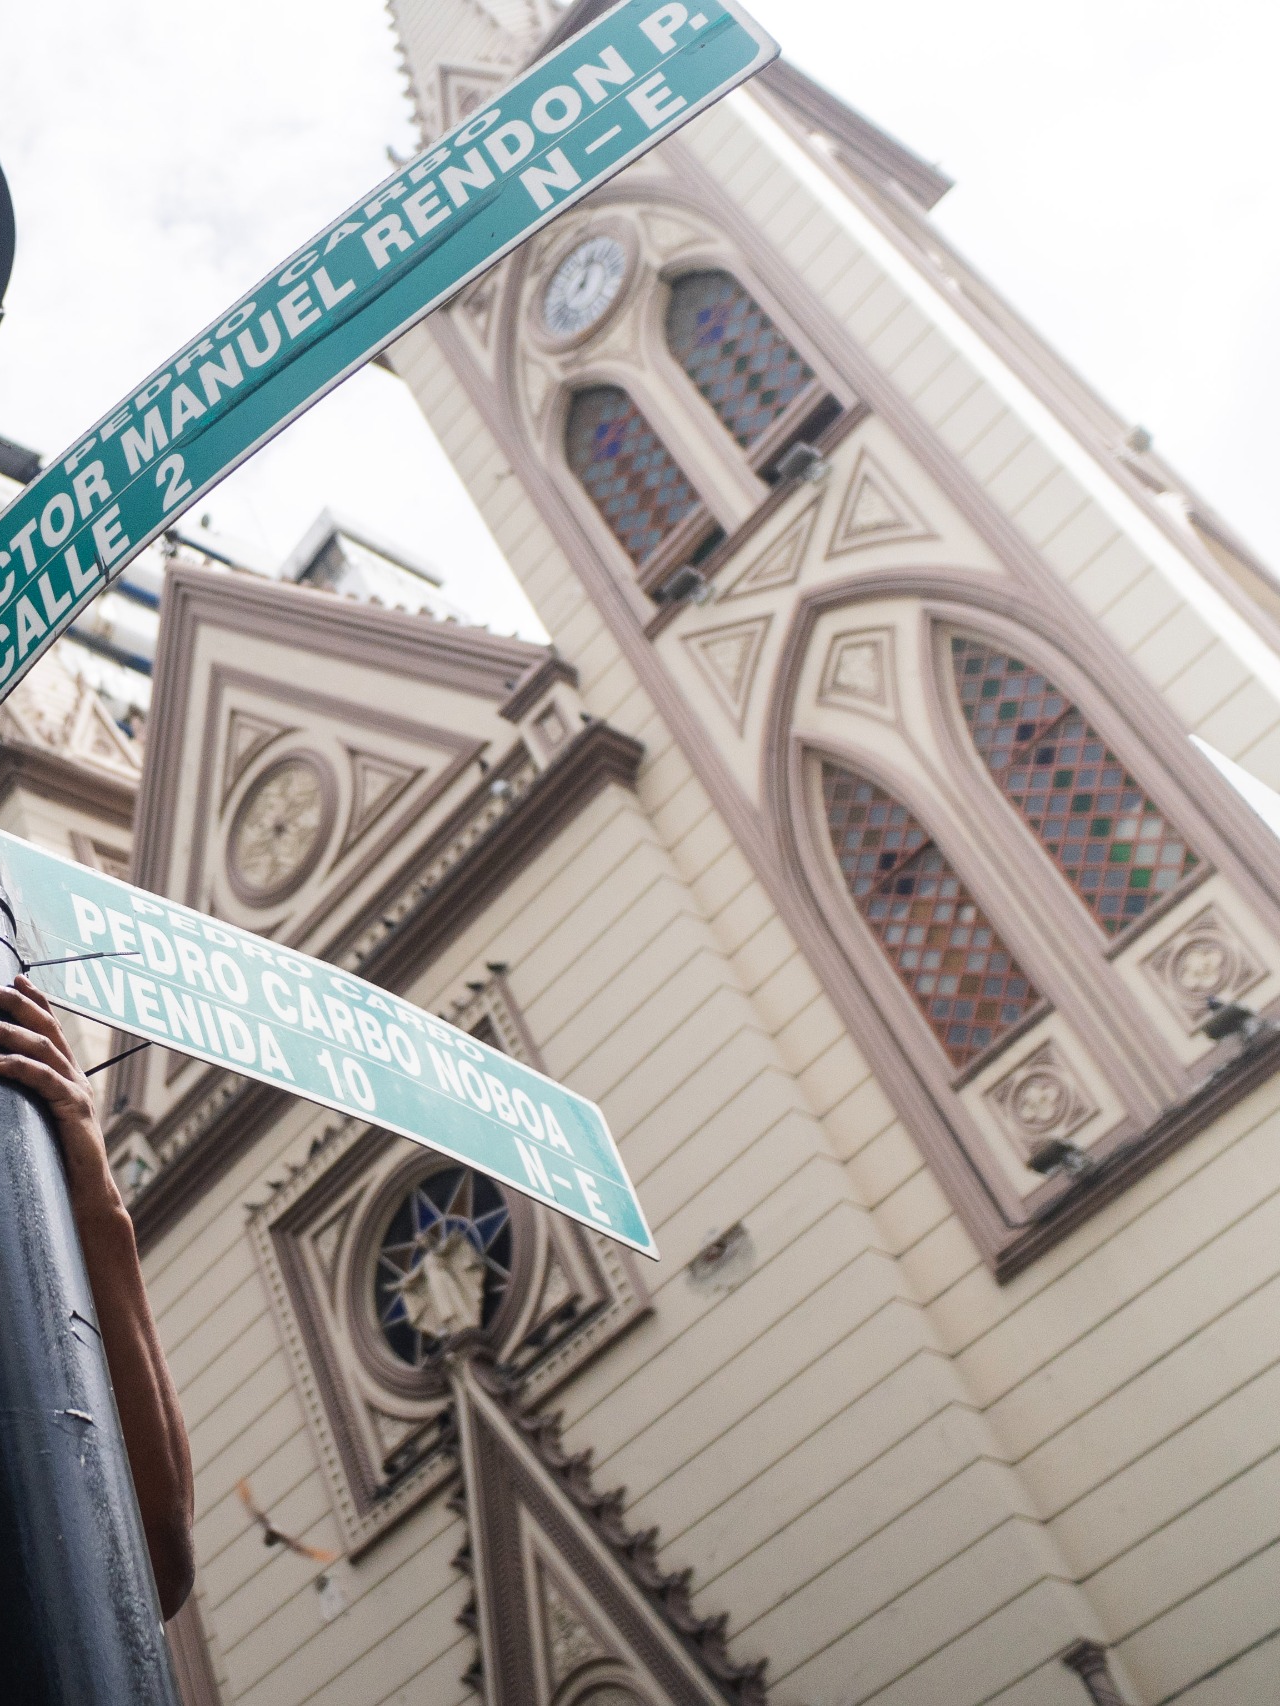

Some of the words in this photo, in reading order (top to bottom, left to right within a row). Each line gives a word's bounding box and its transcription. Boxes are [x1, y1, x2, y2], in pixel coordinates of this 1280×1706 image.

[63, 301, 257, 475] PEDRO
[277, 108, 502, 288] CARBO
[120, 266, 357, 475] MANUEL
[361, 45, 635, 270] RENDON
[639, 2, 709, 55] P.
[156, 453, 192, 512] 2
[65, 948, 295, 1082] AVENIDA
[317, 1047, 376, 1111] 10
[71, 892, 249, 1005] PEDRO
[261, 970, 421, 1077] CARBO
[426, 1041, 575, 1157] NOBOA
[130, 895, 312, 979] PEDRO
[330, 976, 485, 1063] CARBO
